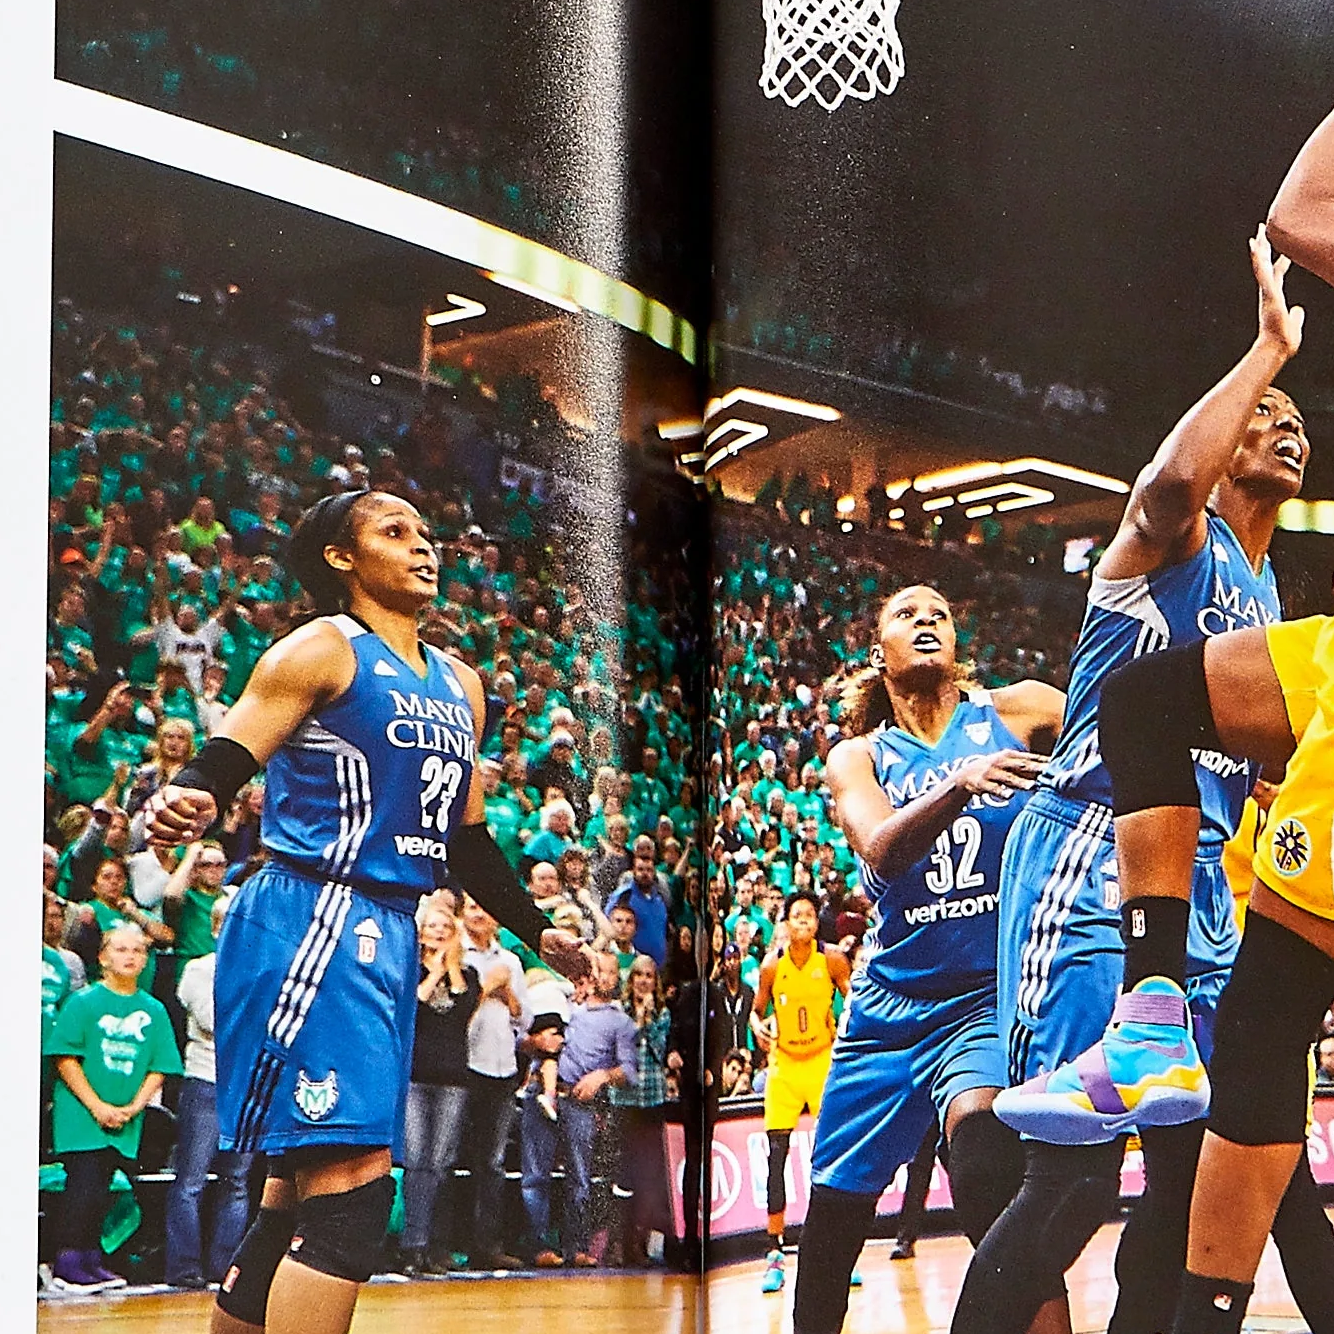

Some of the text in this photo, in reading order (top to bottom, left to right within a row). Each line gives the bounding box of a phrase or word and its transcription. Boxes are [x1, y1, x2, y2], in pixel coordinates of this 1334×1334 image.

[1212, 573, 1280, 628] MAY
[388, 689, 473, 732] MAYO
[885, 754, 989, 806] MAY
[925, 815, 985, 895] 32
[904, 893, 998, 926] verizon
